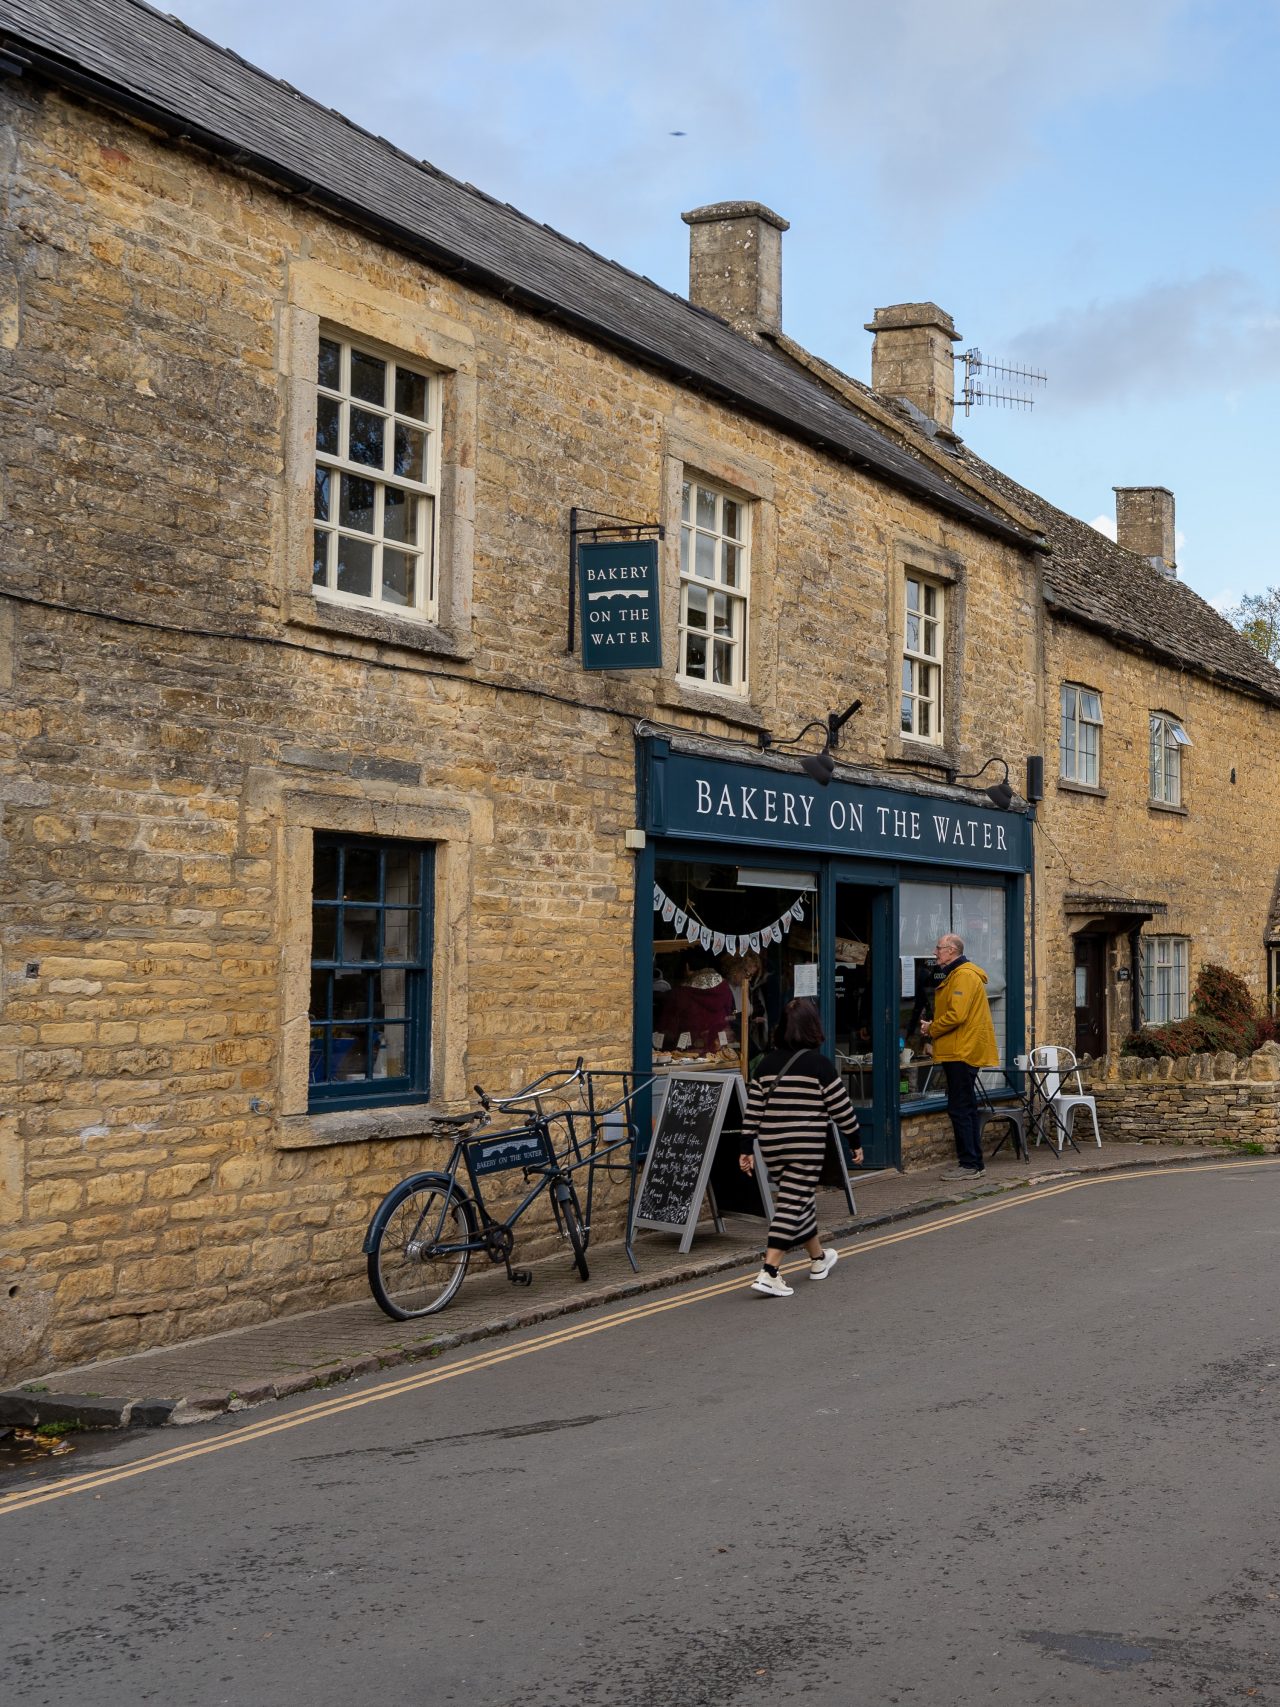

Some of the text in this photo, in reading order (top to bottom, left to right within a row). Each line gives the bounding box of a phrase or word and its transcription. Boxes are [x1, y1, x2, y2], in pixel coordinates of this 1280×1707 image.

[587, 566, 648, 581] BAKERY
[589, 608, 649, 622] ON THE
[591, 631, 651, 645] WATER
[695, 779, 1007, 851] BAKERY ON THE WATER
[653, 893, 698, 934] APPY
[476, 1158, 496, 1170] BAKERY
[509, 1154, 521, 1162] THE
[523, 1150, 543, 1159] WATER
